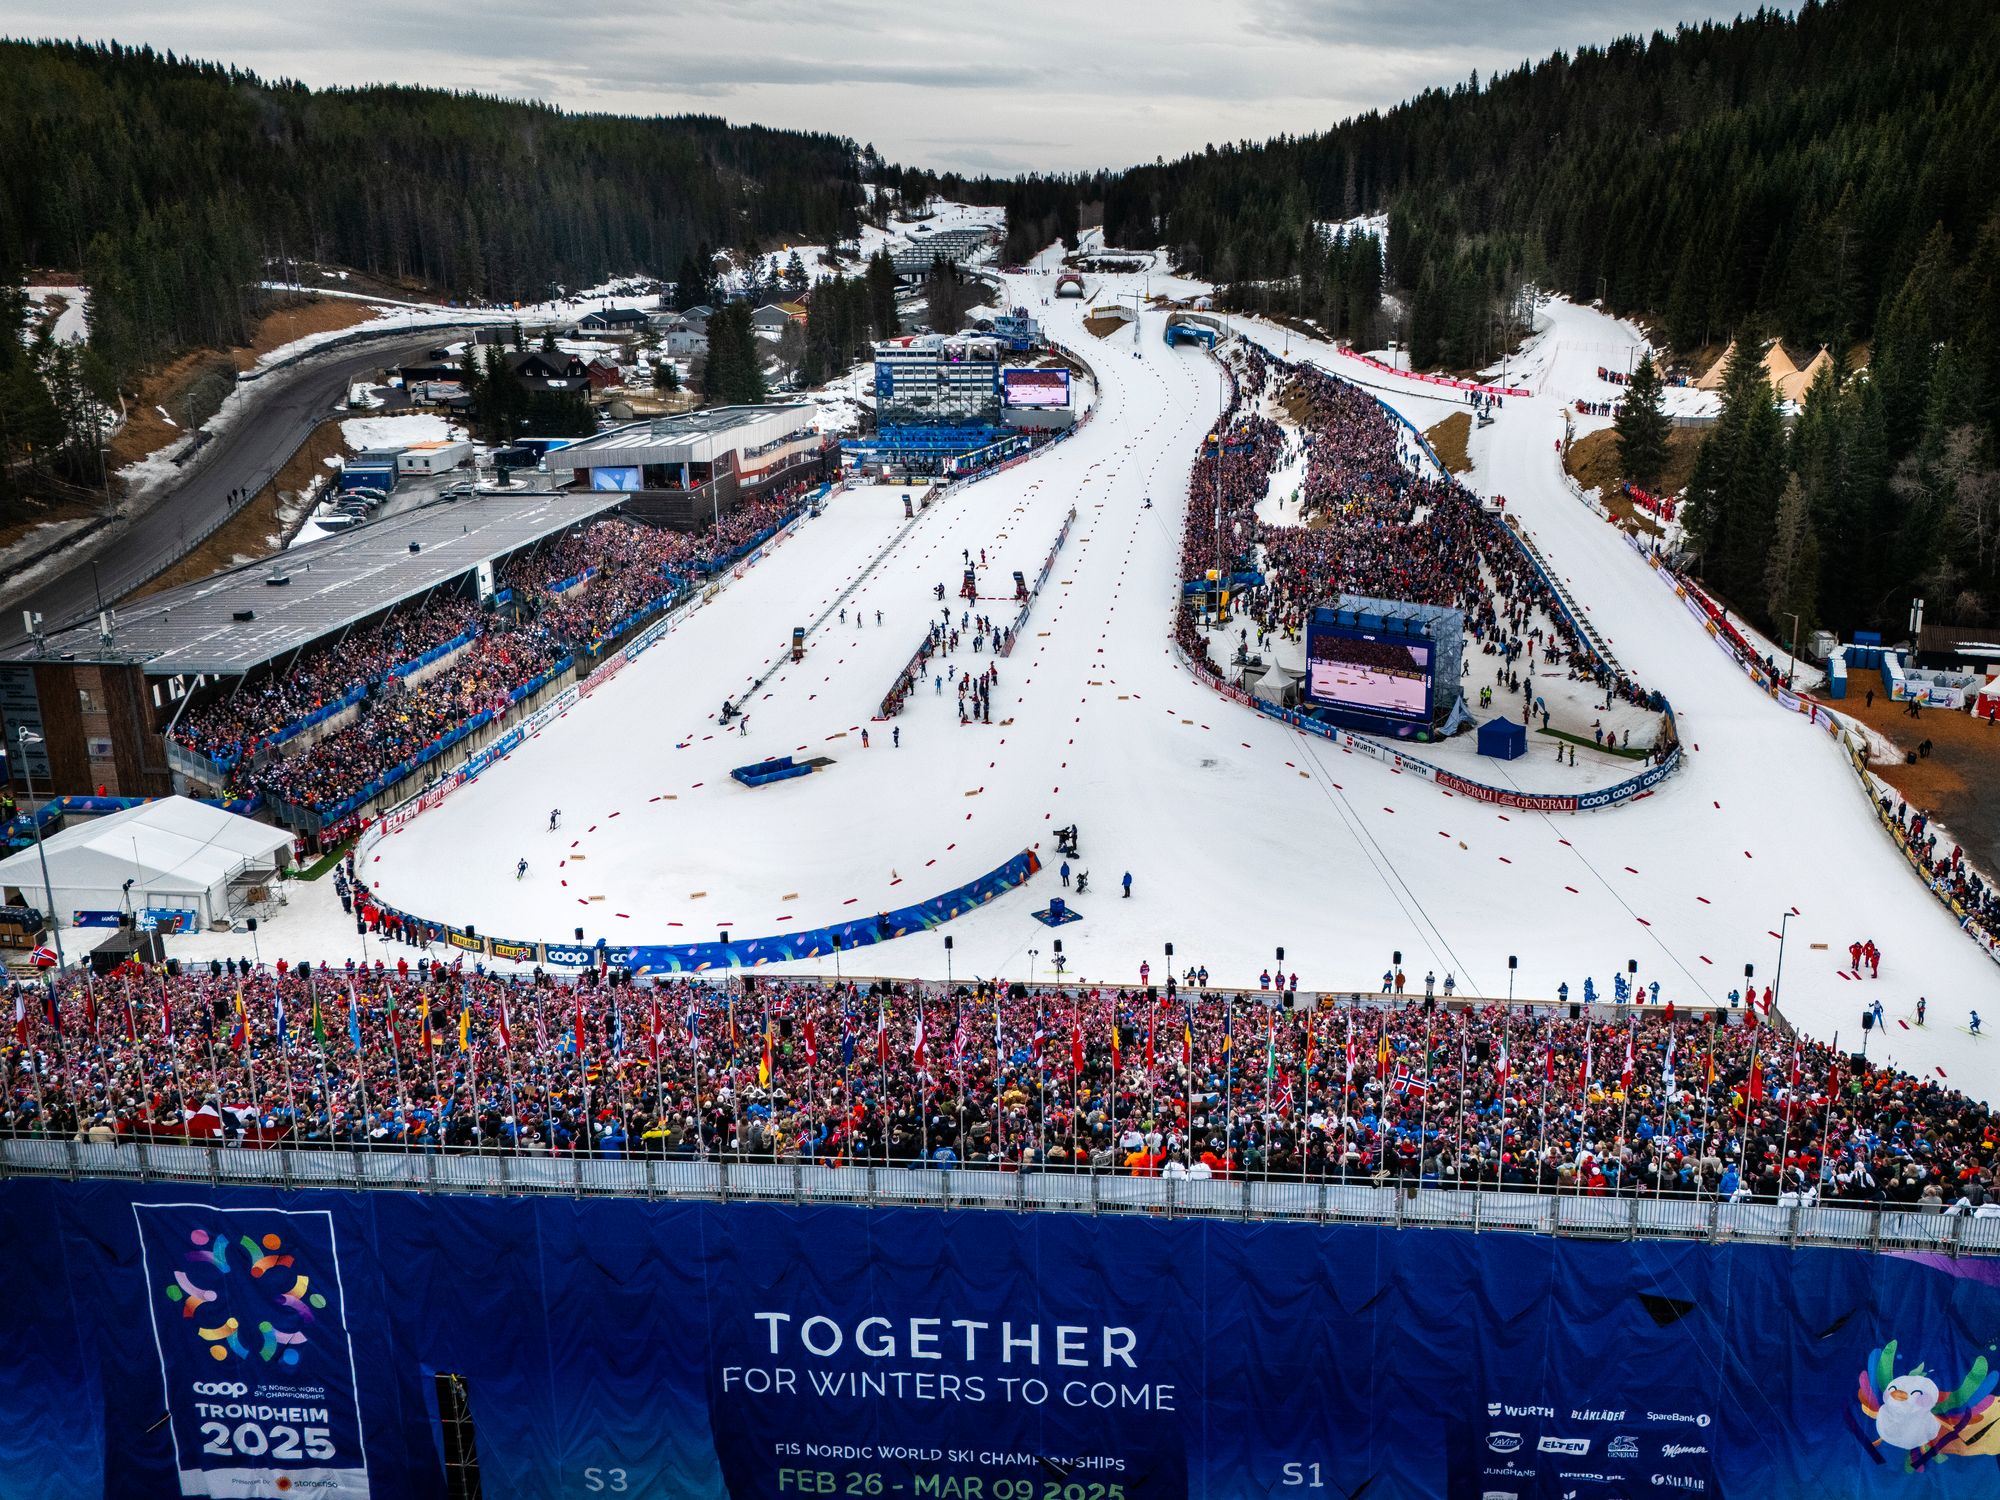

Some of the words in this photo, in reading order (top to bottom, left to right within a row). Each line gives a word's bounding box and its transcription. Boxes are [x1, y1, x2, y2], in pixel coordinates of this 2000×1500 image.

[1196, 667, 1216, 687] ELTEN
[1354, 740, 1376, 754] WÜRTH
[1402, 760, 1427, 775] WÜRTH
[1643, 769, 1664, 786] coop
[1664, 754, 1678, 772] coop
[1449, 778, 1493, 801] GENERALI
[1581, 794, 1610, 807] coop
[1613, 784, 1637, 798] coop
[1516, 798, 1573, 810] GENERALI
[387, 802, 420, 831] ELTEN
[548, 951, 588, 964] coop
[754, 1311, 1138, 1368] TOGETHER
[193, 1381, 248, 1398] coop
[722, 1366, 797, 1395] FOR
[806, 1369, 986, 1402] WINTERS
[996, 1378, 1048, 1406] TO
[1062, 1380, 1176, 1411] COME
[194, 1403, 329, 1424] TRONDHEIM
[1504, 1405, 1555, 1418] WÜRTH
[1571, 1409, 1626, 1421] BLÅKLÄDER
[1647, 1411, 1696, 1423] SpareBank
[201, 1422, 336, 1460] 2025
[1542, 1440, 1584, 1451] ELTEN
[775, 1443, 801, 1455] FIS
[806, 1443, 873, 1459] NORDIC
[877, 1446, 942, 1461] WORLD
[948, 1449, 974, 1462] SKI
[1662, 1444, 1708, 1458] Manner
[584, 1467, 629, 1492] S3
[1281, 1462, 1325, 1488] S1
[1483, 1467, 1536, 1477] JUNGHANS
[778, 1468, 837, 1494] FEB
[846, 1472, 884, 1495] 26
[914, 1473, 983, 1500] MAR
[992, 1479, 1034, 1500] 09
[1043, 1482, 1126, 1500] 2025
